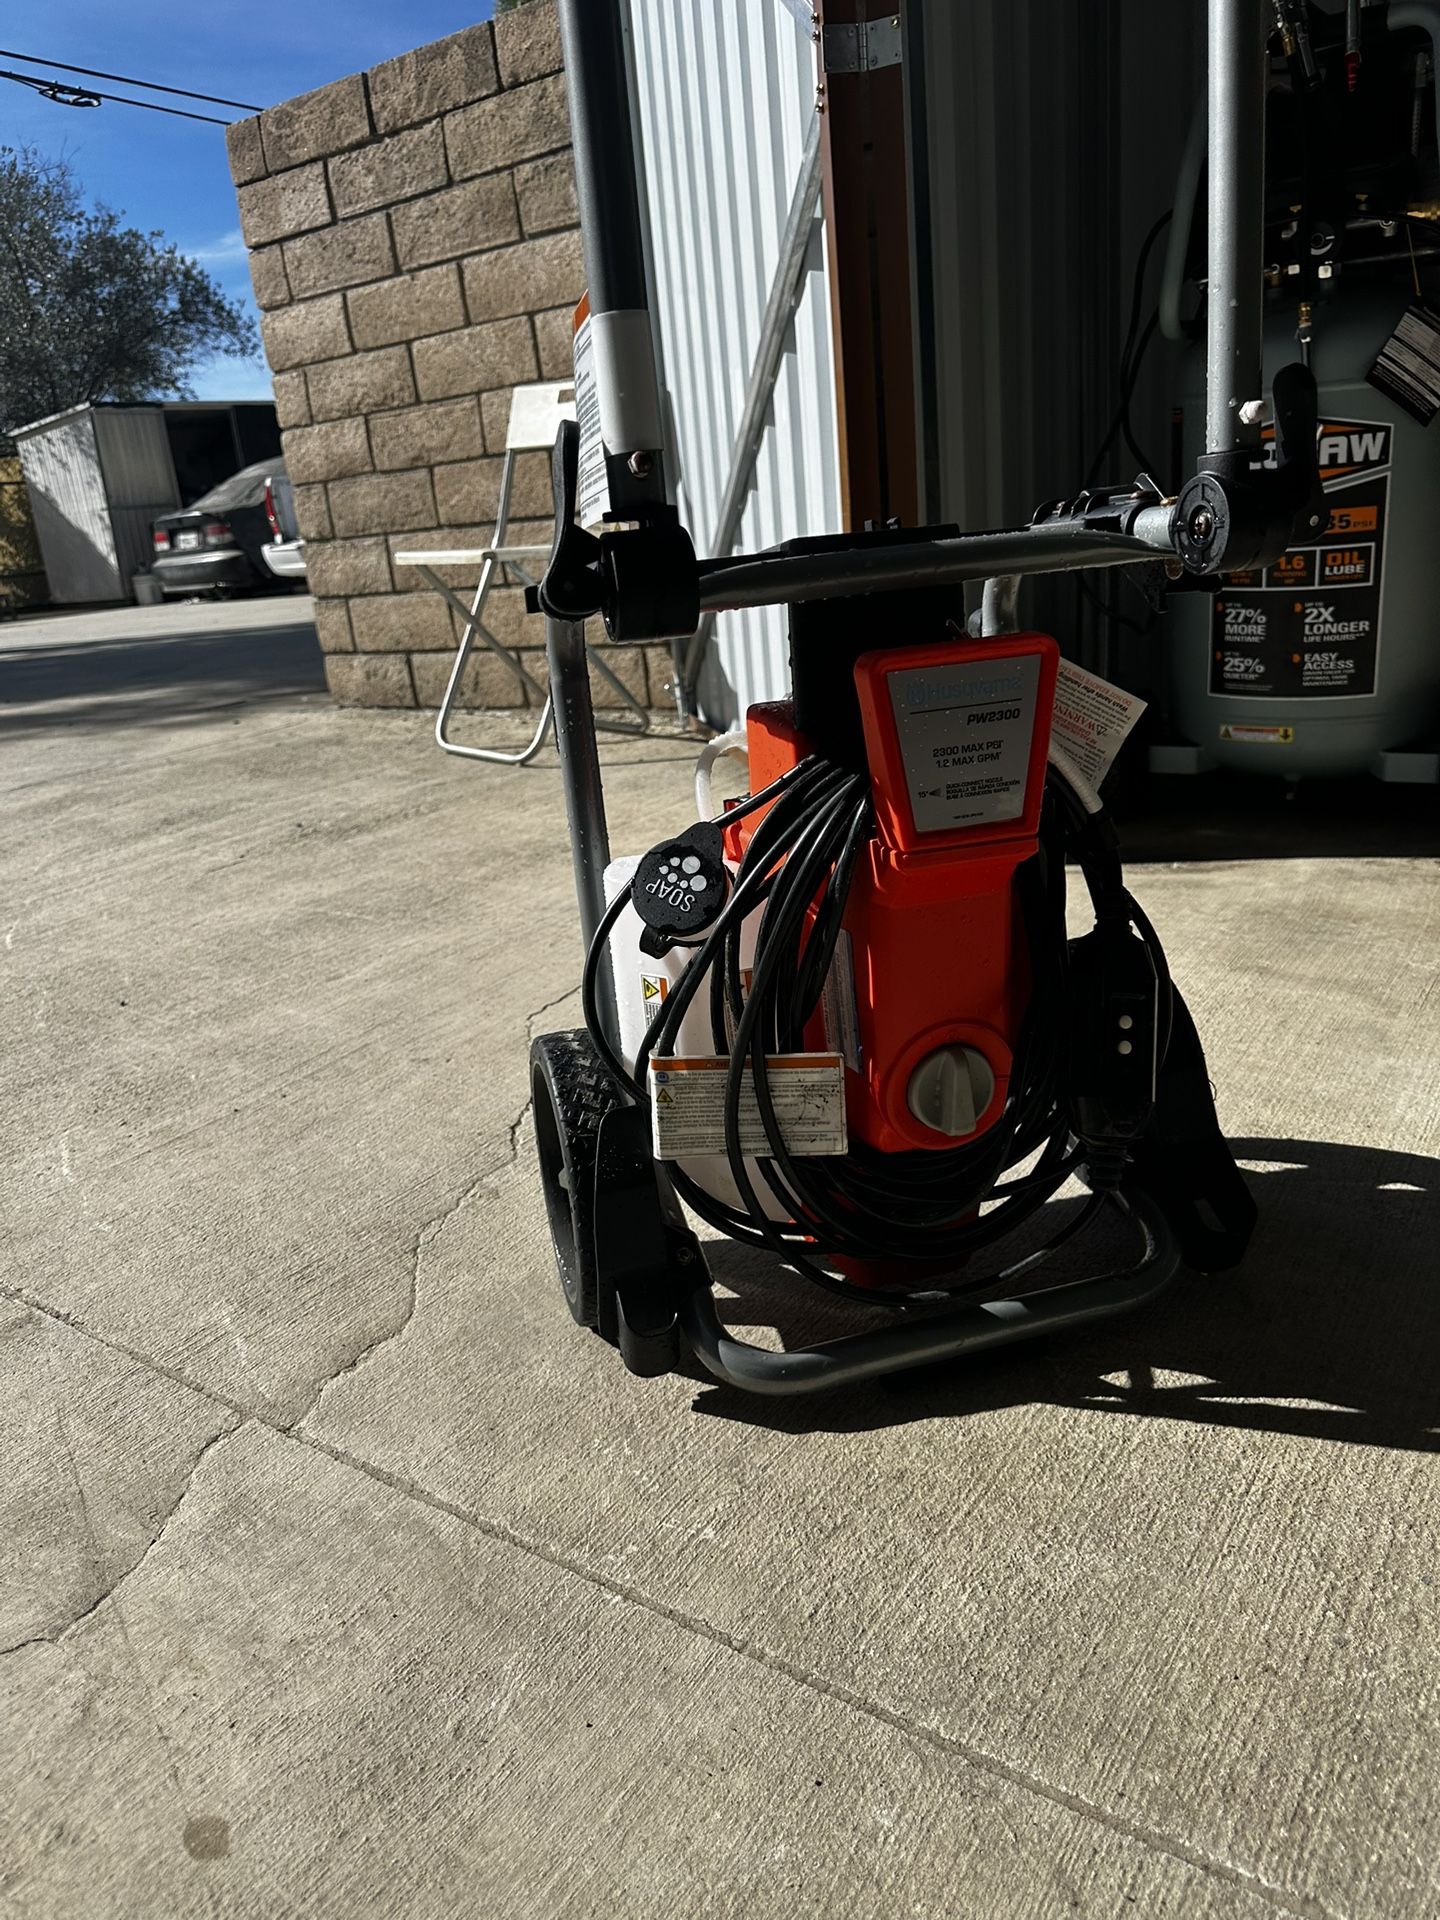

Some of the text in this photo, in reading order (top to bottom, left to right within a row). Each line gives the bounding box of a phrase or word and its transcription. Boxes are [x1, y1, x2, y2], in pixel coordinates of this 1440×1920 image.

[1279, 555, 1305, 571] 1.6
[1326, 551, 1365, 566] OIL
[1324, 564, 1366, 576] LUBE
[1224, 608, 1267, 624] 27%
[1303, 606, 1336, 623] 2X
[1224, 623, 1267, 636] MORE
[1304, 620, 1370, 635] LONGER
[1303, 635, 1322, 643] LIFE
[1303, 652, 1339, 663] EASY
[1223, 657, 1266, 674] 25%
[1303, 660, 1355, 671] ACCESS
[1094, 692, 1113, 705] hands
[1112, 700, 1128, 713] Wash
[966, 707, 1021, 726] PW2300
[932, 745, 960, 758] 2300
[961, 743, 984, 754] MAX
[935, 758, 950, 768] 1.2
[952, 755, 975, 767] MAX
[646, 878, 696, 912] SOAP
